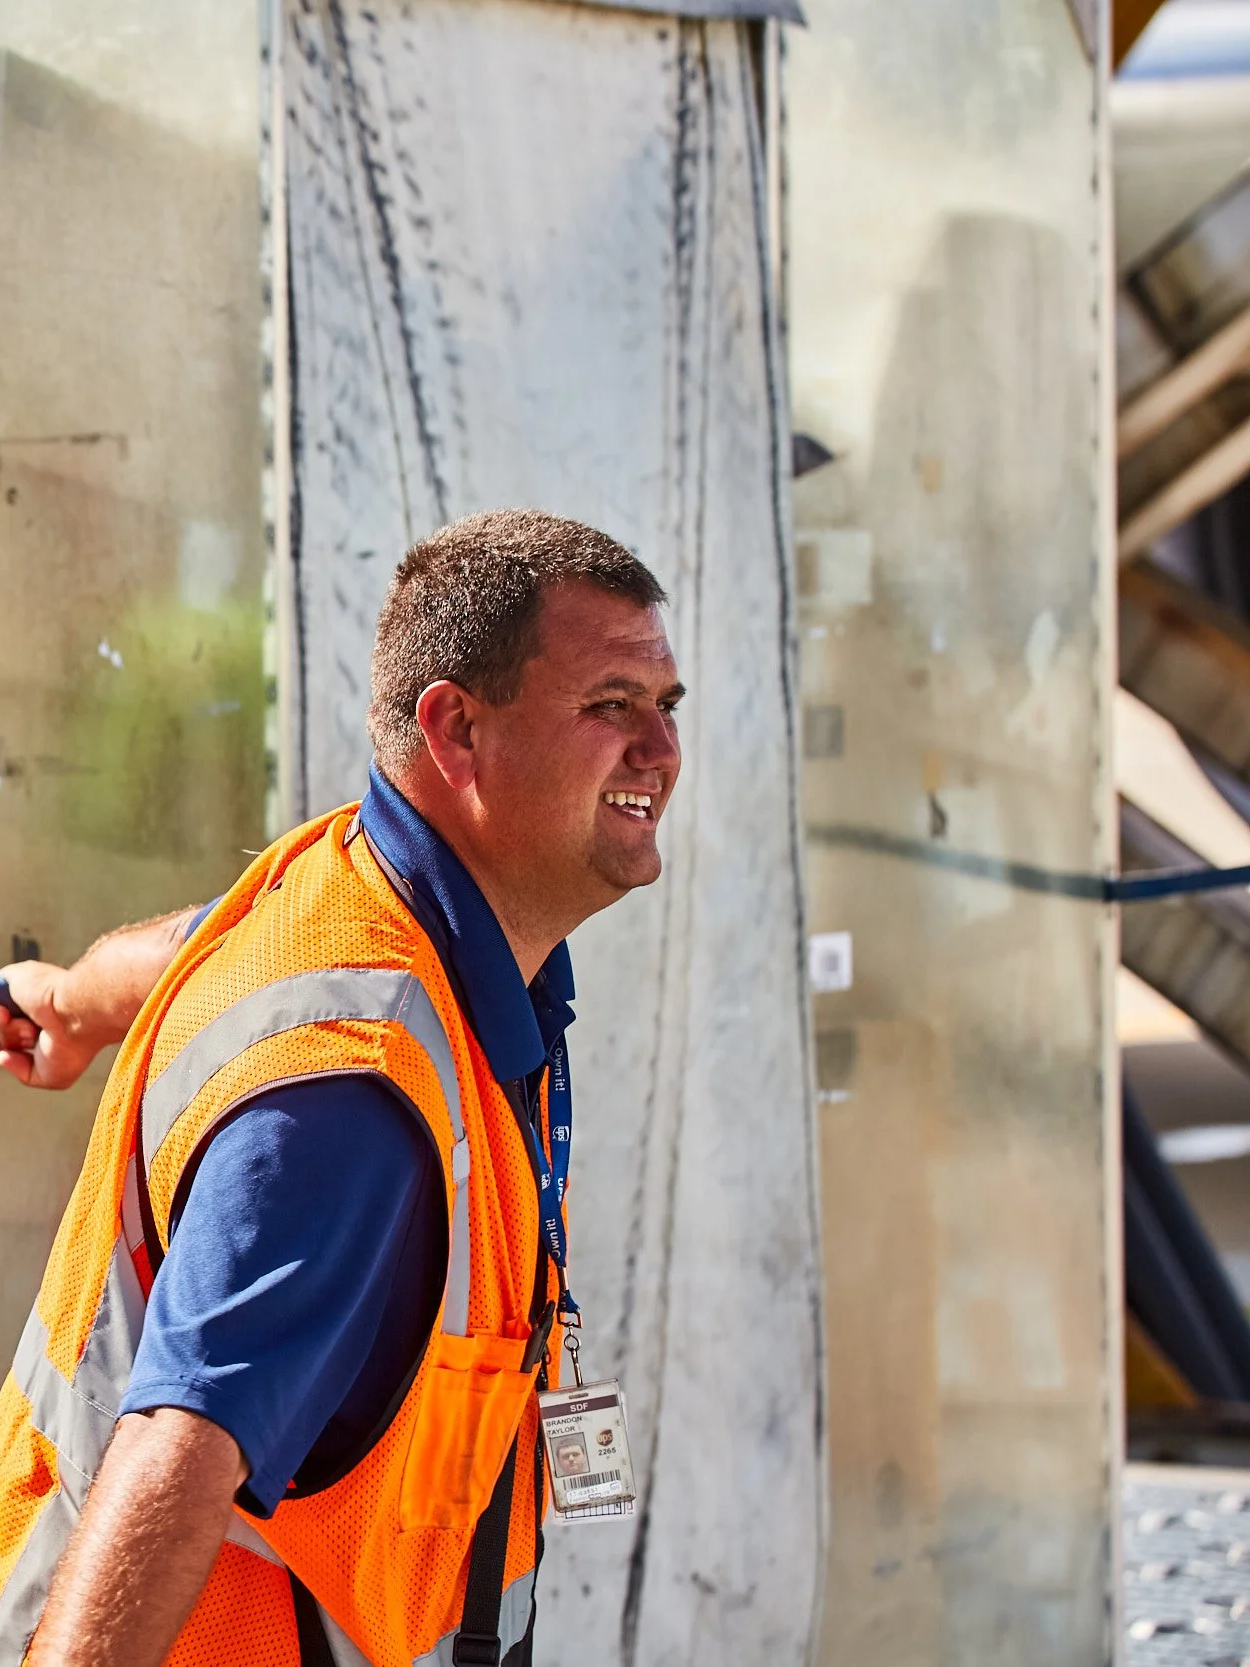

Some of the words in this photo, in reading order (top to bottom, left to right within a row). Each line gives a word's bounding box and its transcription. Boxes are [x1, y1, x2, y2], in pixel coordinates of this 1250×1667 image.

[554, 1047, 564, 1076] Own
[554, 1078, 566, 1091] it!
[545, 1218, 557, 1231] it!
[569, 1402, 589, 1413] SDF
[546, 1415, 583, 1427] BRANDON
[547, 1426, 576, 1436] TAYLOR
[597, 1433, 613, 1446] ups
